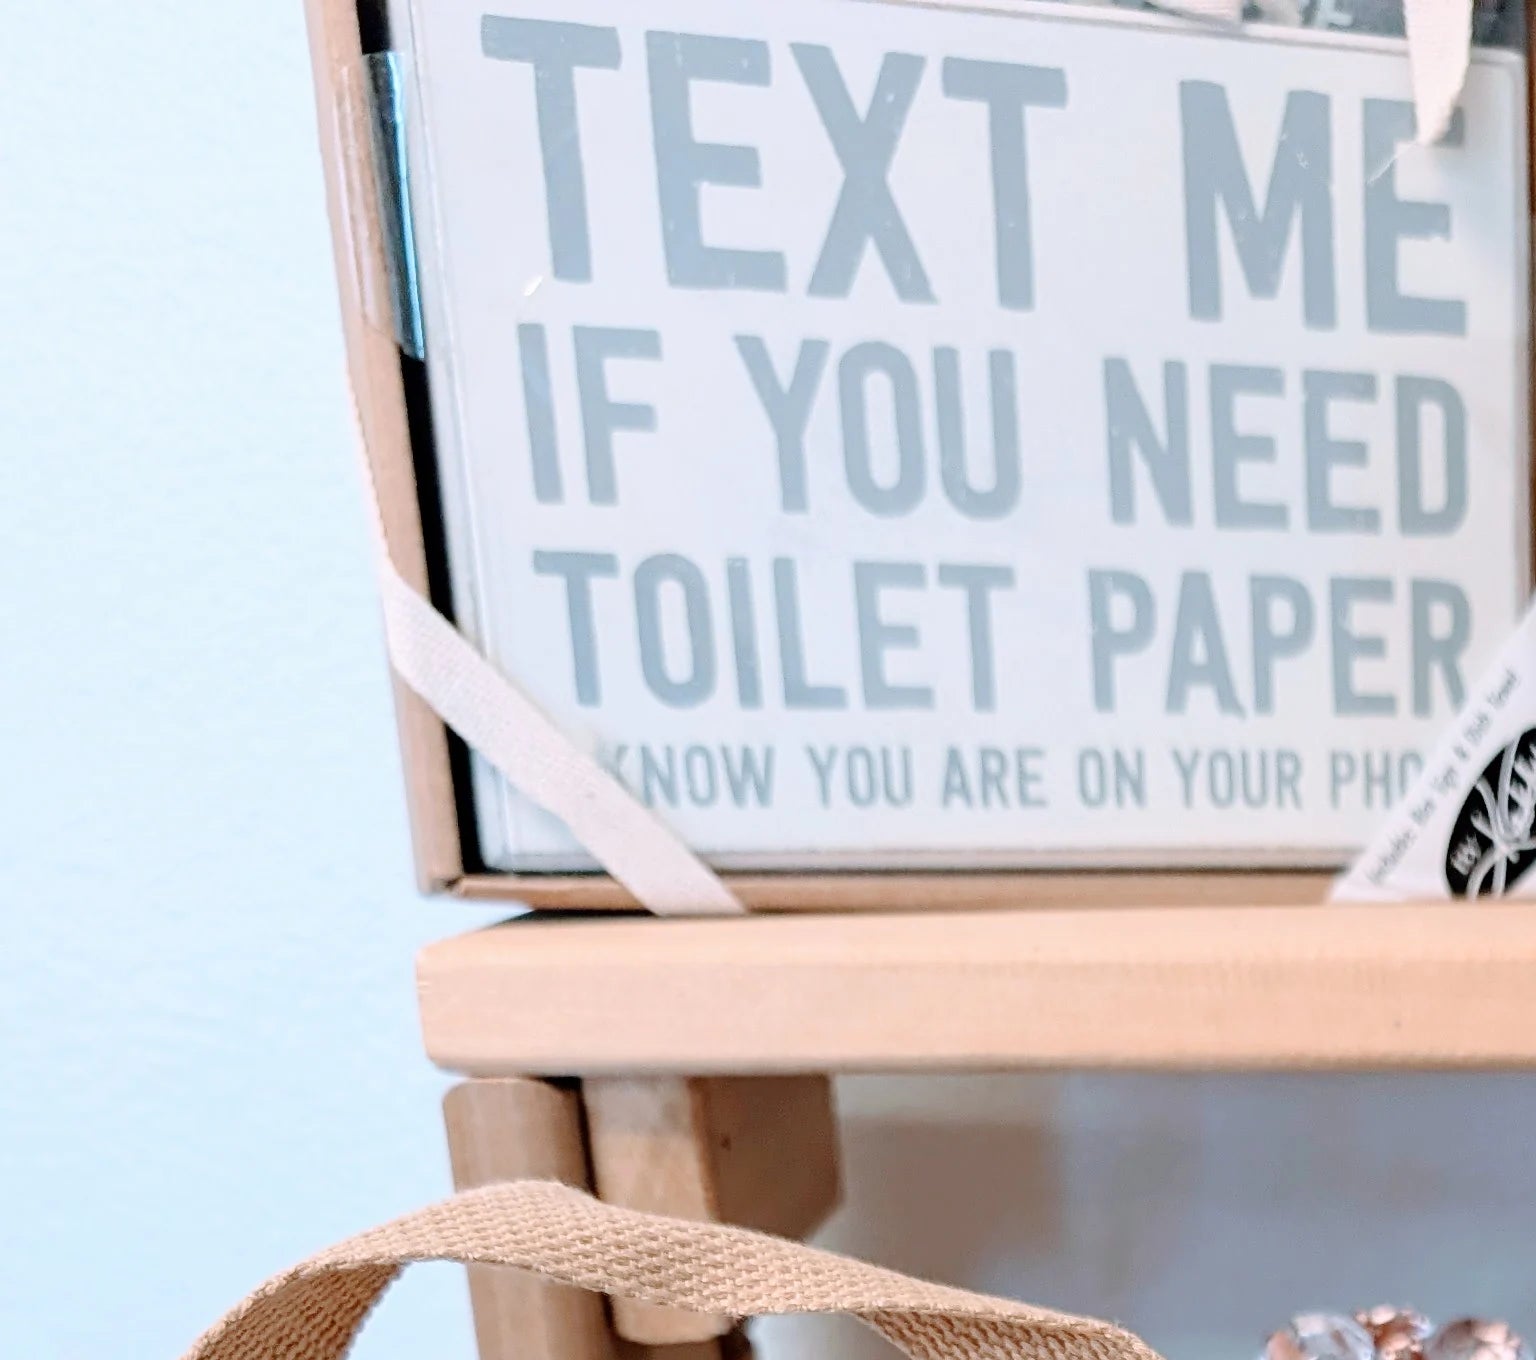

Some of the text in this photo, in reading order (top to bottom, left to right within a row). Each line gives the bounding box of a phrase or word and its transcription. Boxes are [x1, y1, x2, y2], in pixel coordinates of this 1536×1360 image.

[481, 14, 1467, 338] TEXT ME
[517, 322, 1469, 536] IF YOU NEED
[532, 549, 1474, 719] TOILET PAPER
[806, 747, 913, 809] YOU
[941, 747, 1047, 809] ARE
[1078, 748, 1146, 810] ON
[1172, 749, 1303, 811] YOUR
[1331, 748, 1426, 811] PHO
